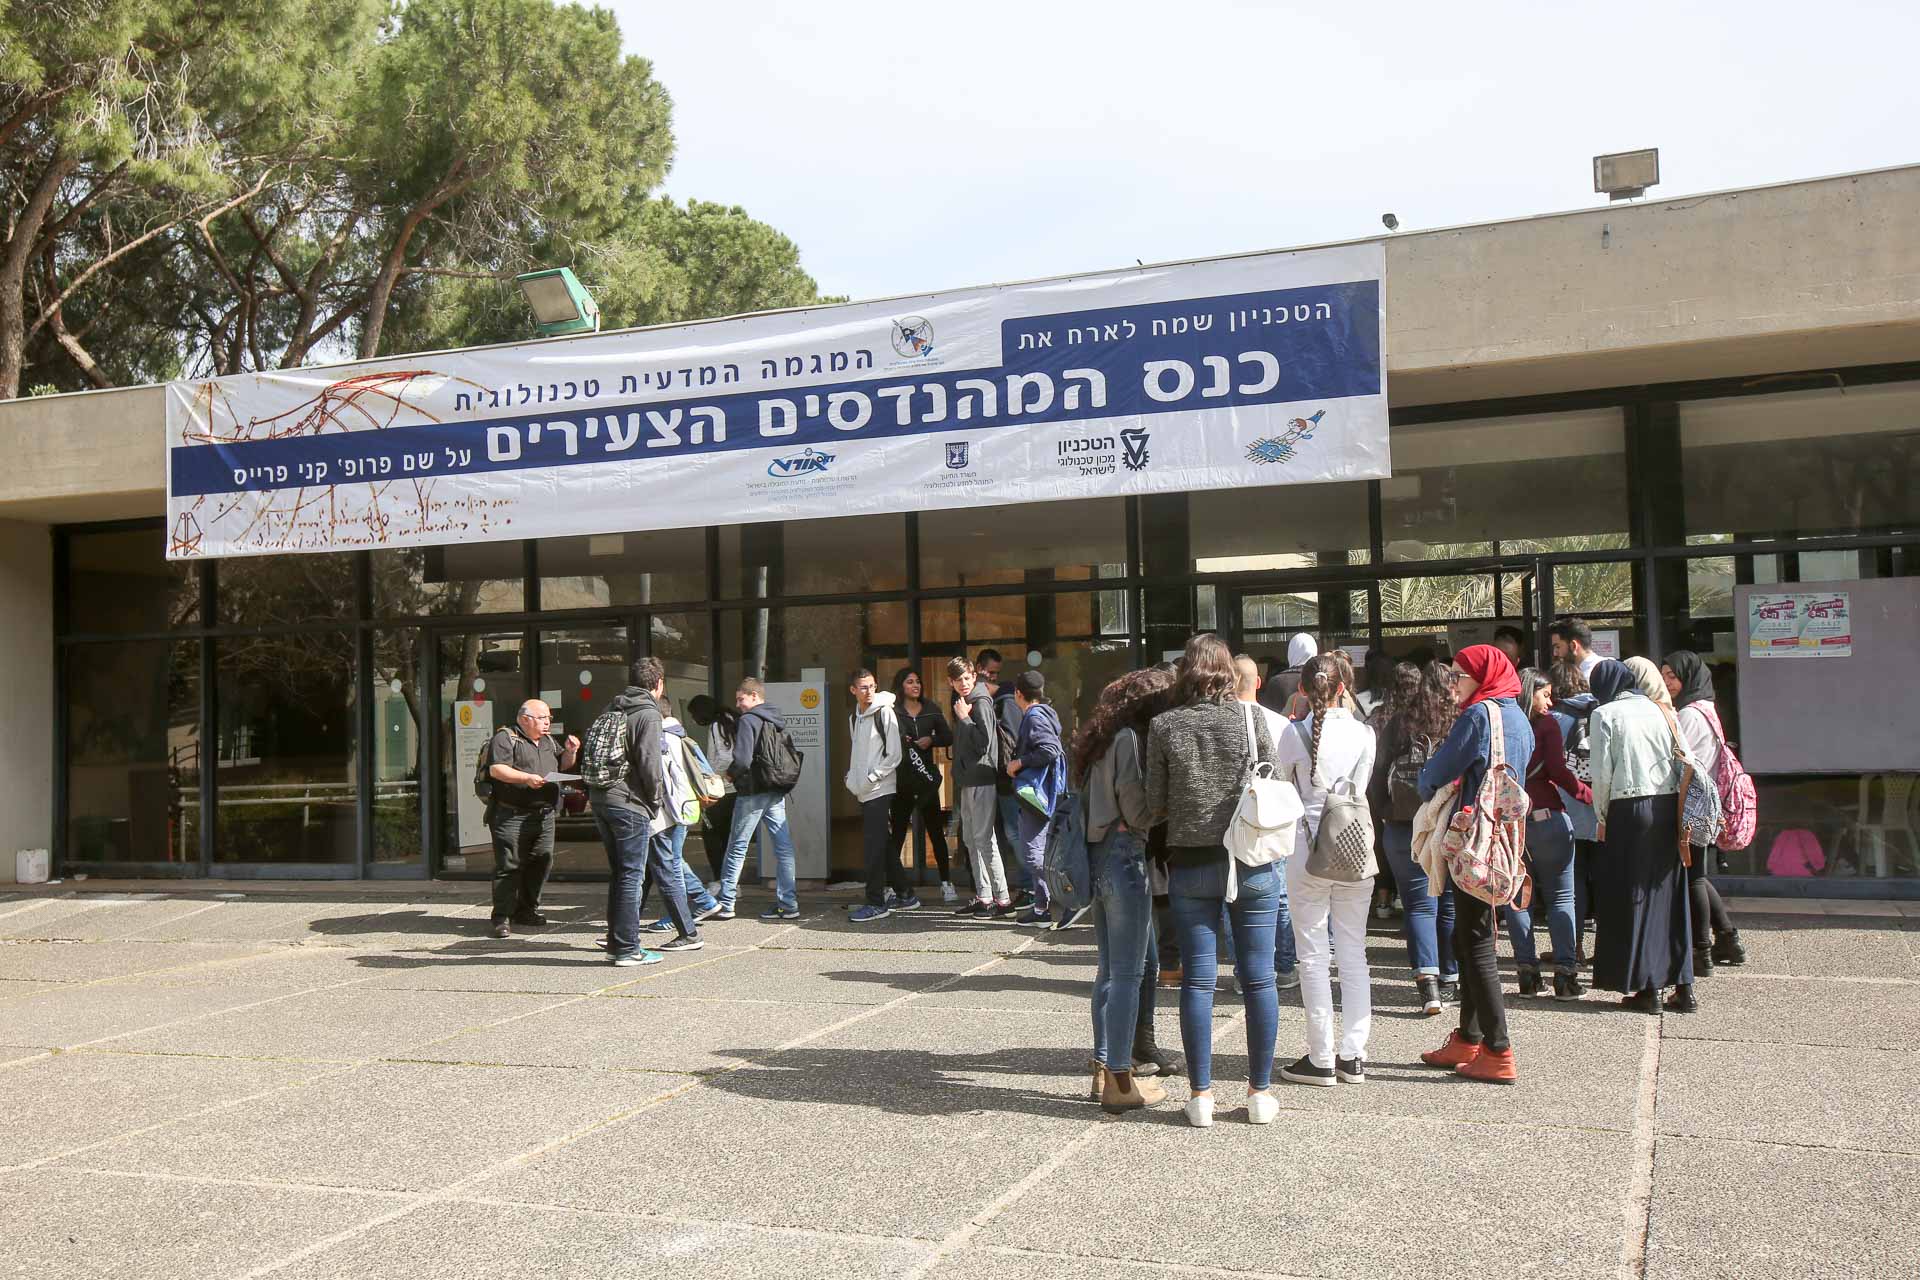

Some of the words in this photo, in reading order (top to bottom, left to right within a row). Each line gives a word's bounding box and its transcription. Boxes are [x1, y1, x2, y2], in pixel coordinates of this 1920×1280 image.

[1152, 313, 1213, 337] שמח
[1229, 301, 1332, 332] הטכניון
[1018, 330, 1052, 350] את
[1067, 319, 1137, 345] לארח
[761, 349, 873, 381] המגמה
[1143, 350, 1280, 402] כנס
[619, 363, 740, 394] המדעית
[454, 379, 600, 412] טכנולוגית
[758, 367, 1107, 437] המהנדסים
[486, 405, 727, 462] הצעירים
[445, 447, 471, 468] על
[1058, 437, 1115, 456] הטכניון
[298, 461, 328, 484] קני
[403, 452, 434, 472] שם
[1057, 456, 1093, 467] טכנולוגי
[1079, 465, 1115, 476] לישראל
[1097, 455, 1115, 467] מכון
[233, 465, 288, 486] פרייס
